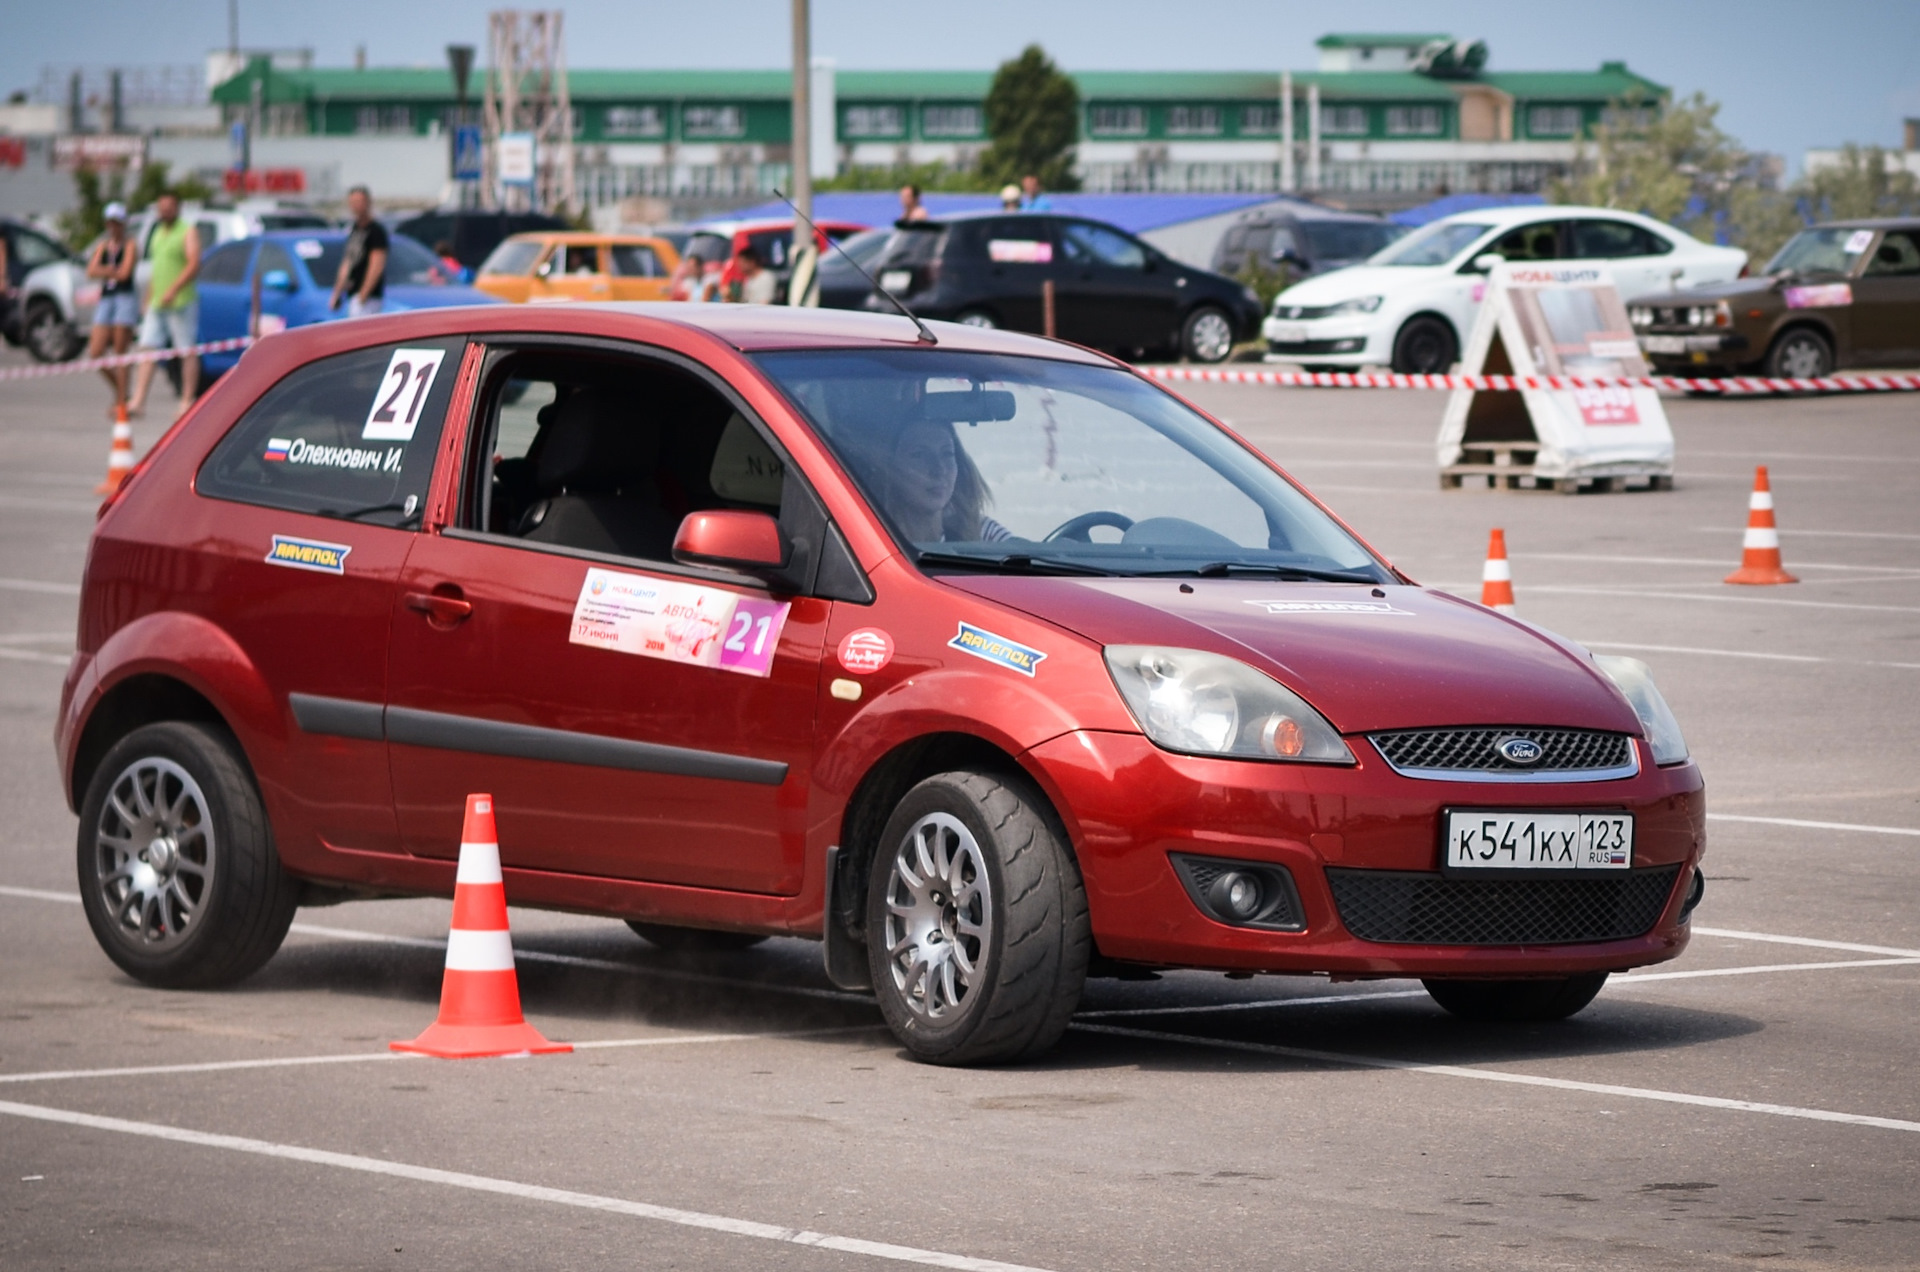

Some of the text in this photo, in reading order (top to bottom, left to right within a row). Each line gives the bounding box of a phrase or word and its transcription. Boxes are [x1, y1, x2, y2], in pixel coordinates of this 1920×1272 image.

[1510, 270, 1600, 283] НОВАЦЕНТР
[372, 361, 434, 423] 21
[288, 438, 402, 473] Олехнович И.
[276, 543, 339, 565] RAVENOL
[611, 585, 657, 598] НОВАЦЕНТР
[577, 624, 619, 642] 17 июня
[725, 611, 773, 655] 21
[645, 639, 665, 652] 2018
[960, 631, 1031, 667] RAVENOL
[1511, 743, 1535, 759] Ford
[1584, 819, 1625, 850] 123
[1588, 852, 1610, 863] RUS
